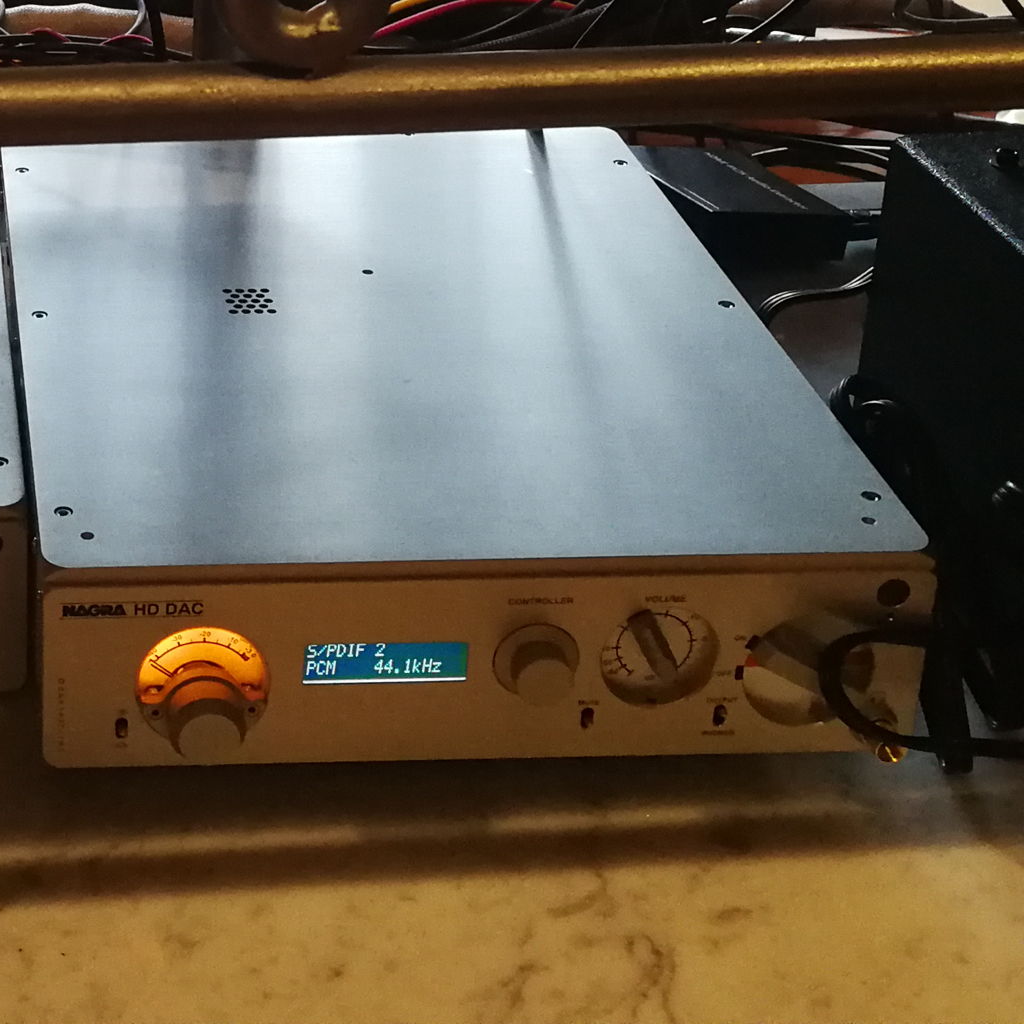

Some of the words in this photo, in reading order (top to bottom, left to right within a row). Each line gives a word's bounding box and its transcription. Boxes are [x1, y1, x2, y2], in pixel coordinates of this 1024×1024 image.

[508, 596, 574, 605] CONTROLLER
[645, 595, 687, 603] VOLUME
[62, 604, 126, 616] NAGRA
[134, 604, 159, 615] HD
[166, 603, 204, 615] DAC
[307, 643, 367, 658] S/PDIF
[374, 643, 386, 657] 2
[306, 660, 337, 676] PCM
[373, 658, 442, 674] 44.1kHz
